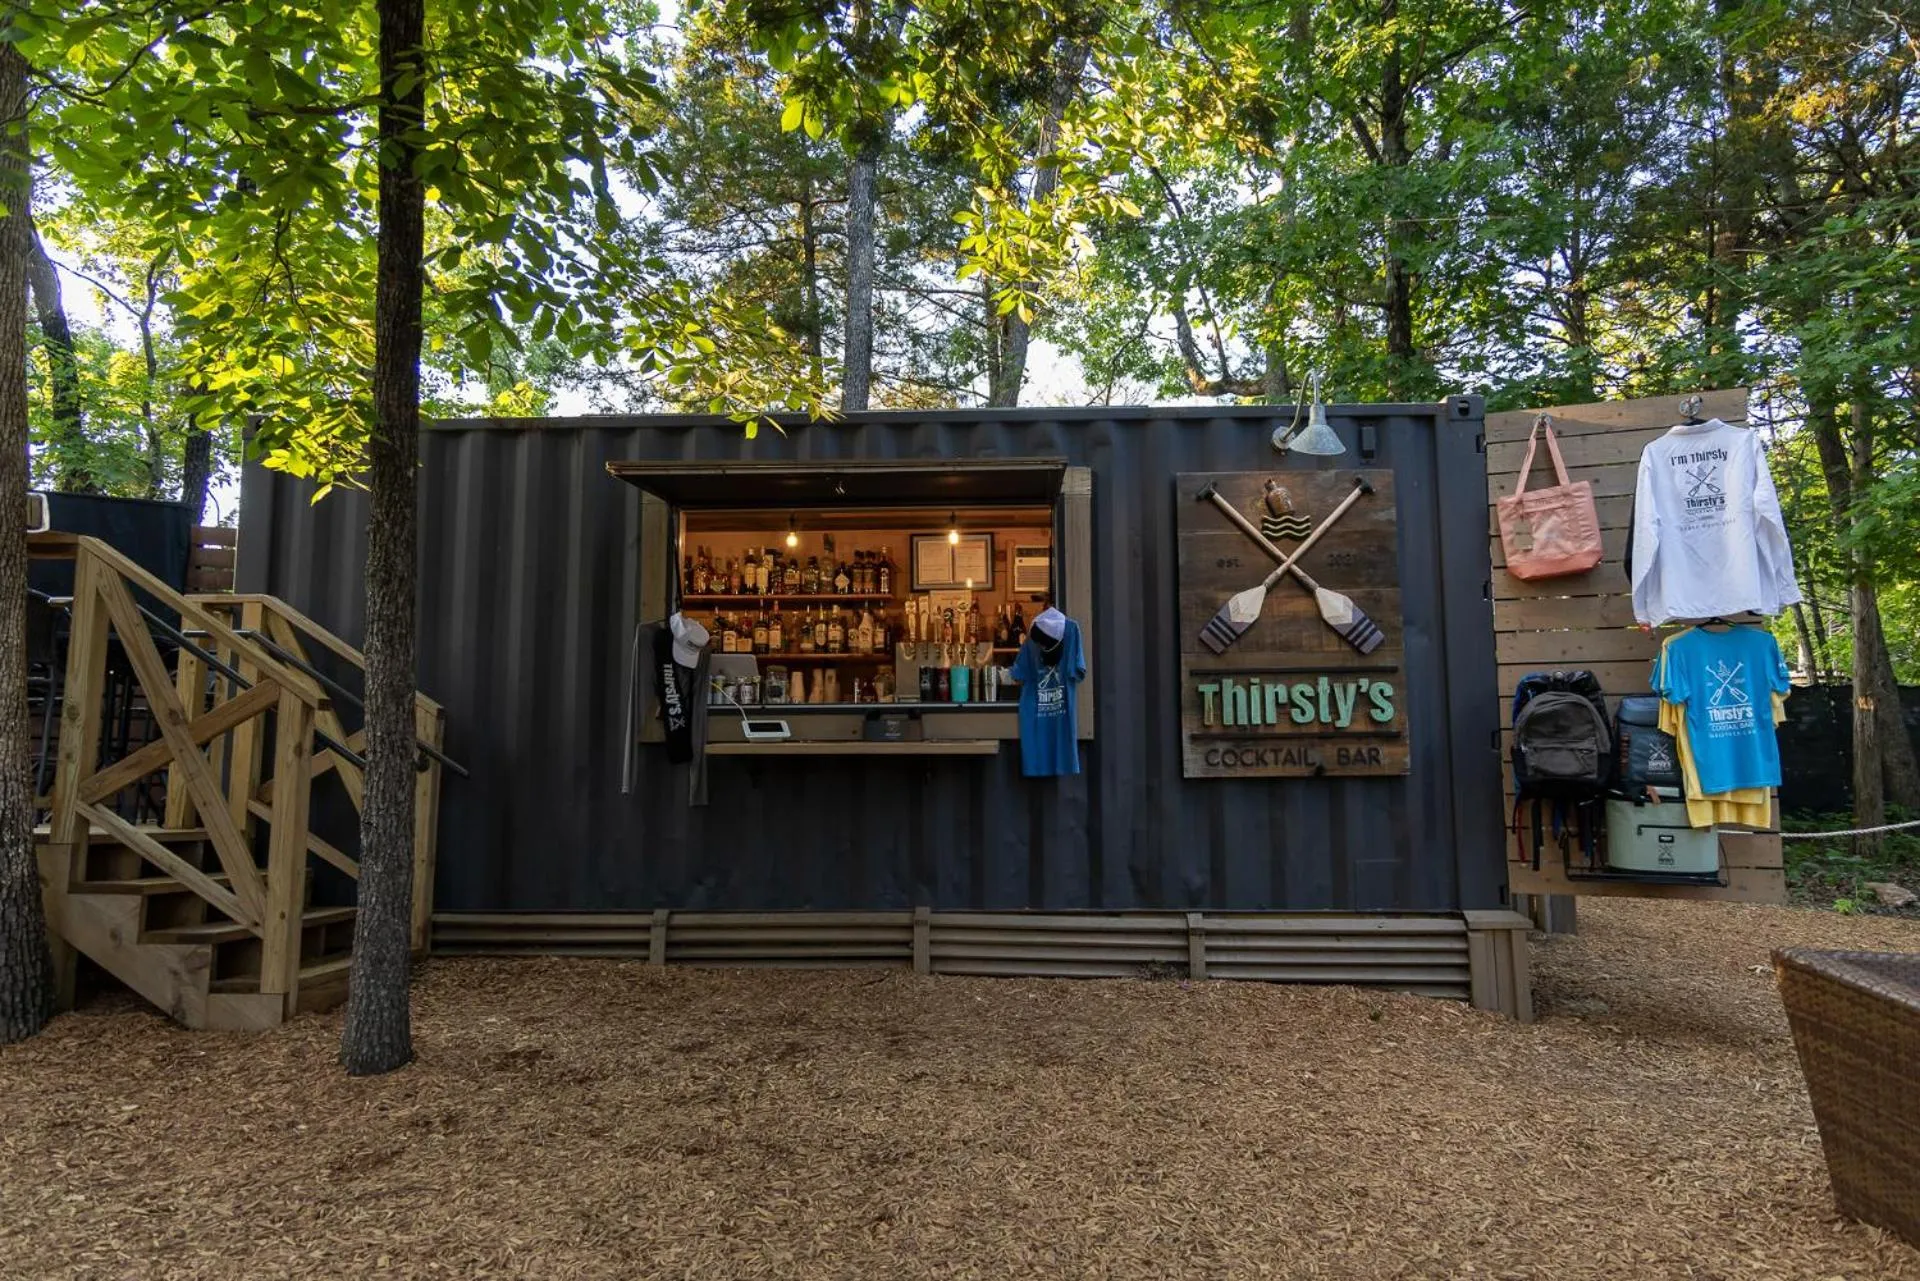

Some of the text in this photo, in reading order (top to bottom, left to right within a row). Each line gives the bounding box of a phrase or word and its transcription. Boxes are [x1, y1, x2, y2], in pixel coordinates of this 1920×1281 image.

[1689, 448, 1728, 463] Thirsty
[1686, 495, 1725, 508] Thirsty's
[663, 663, 682, 715] Thirsty's
[1197, 674, 1396, 728] Thirsty's
[1708, 706, 1753, 721] Thirsty's
[1205, 747, 1382, 768] COCKTAIL BAR
